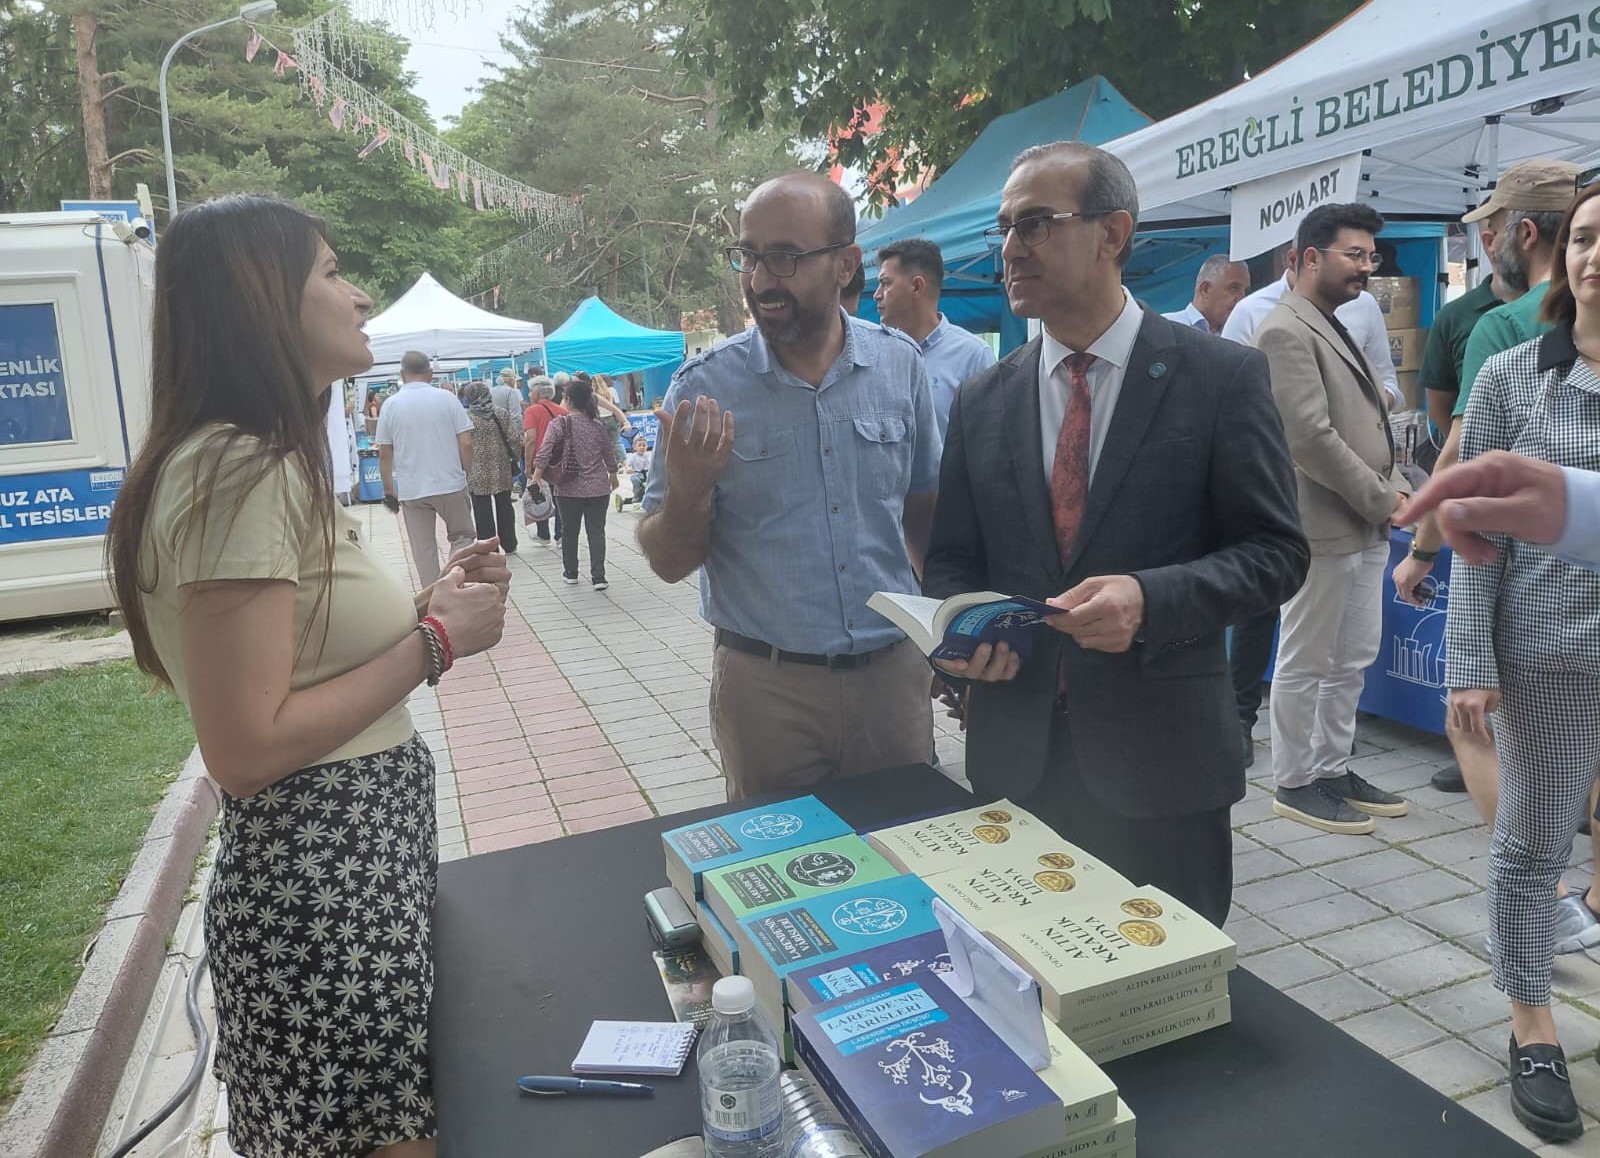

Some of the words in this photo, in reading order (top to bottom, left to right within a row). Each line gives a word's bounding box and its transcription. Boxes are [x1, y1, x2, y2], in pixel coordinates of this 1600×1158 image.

[1259, 189, 1305, 231] NOVA
[1308, 167, 1340, 208] ART
[0, 491, 30, 507] UZ
[34, 487, 75, 504] ATA
[913, 831, 944, 852] ALTIN
[924, 823, 968, 855] KRALLIK
[966, 878, 1005, 903] ALTIN
[980, 868, 1033, 906] KRALLIK
[1041, 927, 1089, 960] ALTIN
[1056, 916, 1119, 963] KRALLIK
[1126, 977, 1148, 993] ALTIN
[1150, 967, 1182, 986] KRALLIK
[1184, 958, 1206, 975] LİDYA
[1119, 1004, 1140, 1018] ALTIN
[1143, 994, 1174, 1011] KRALLIK
[1176, 984, 1198, 1000] LİDYA
[1121, 1032, 1143, 1047] ALTIN
[1146, 1022, 1176, 1039] KRALLIK
[1179, 1012, 1200, 1028] LİDYA
